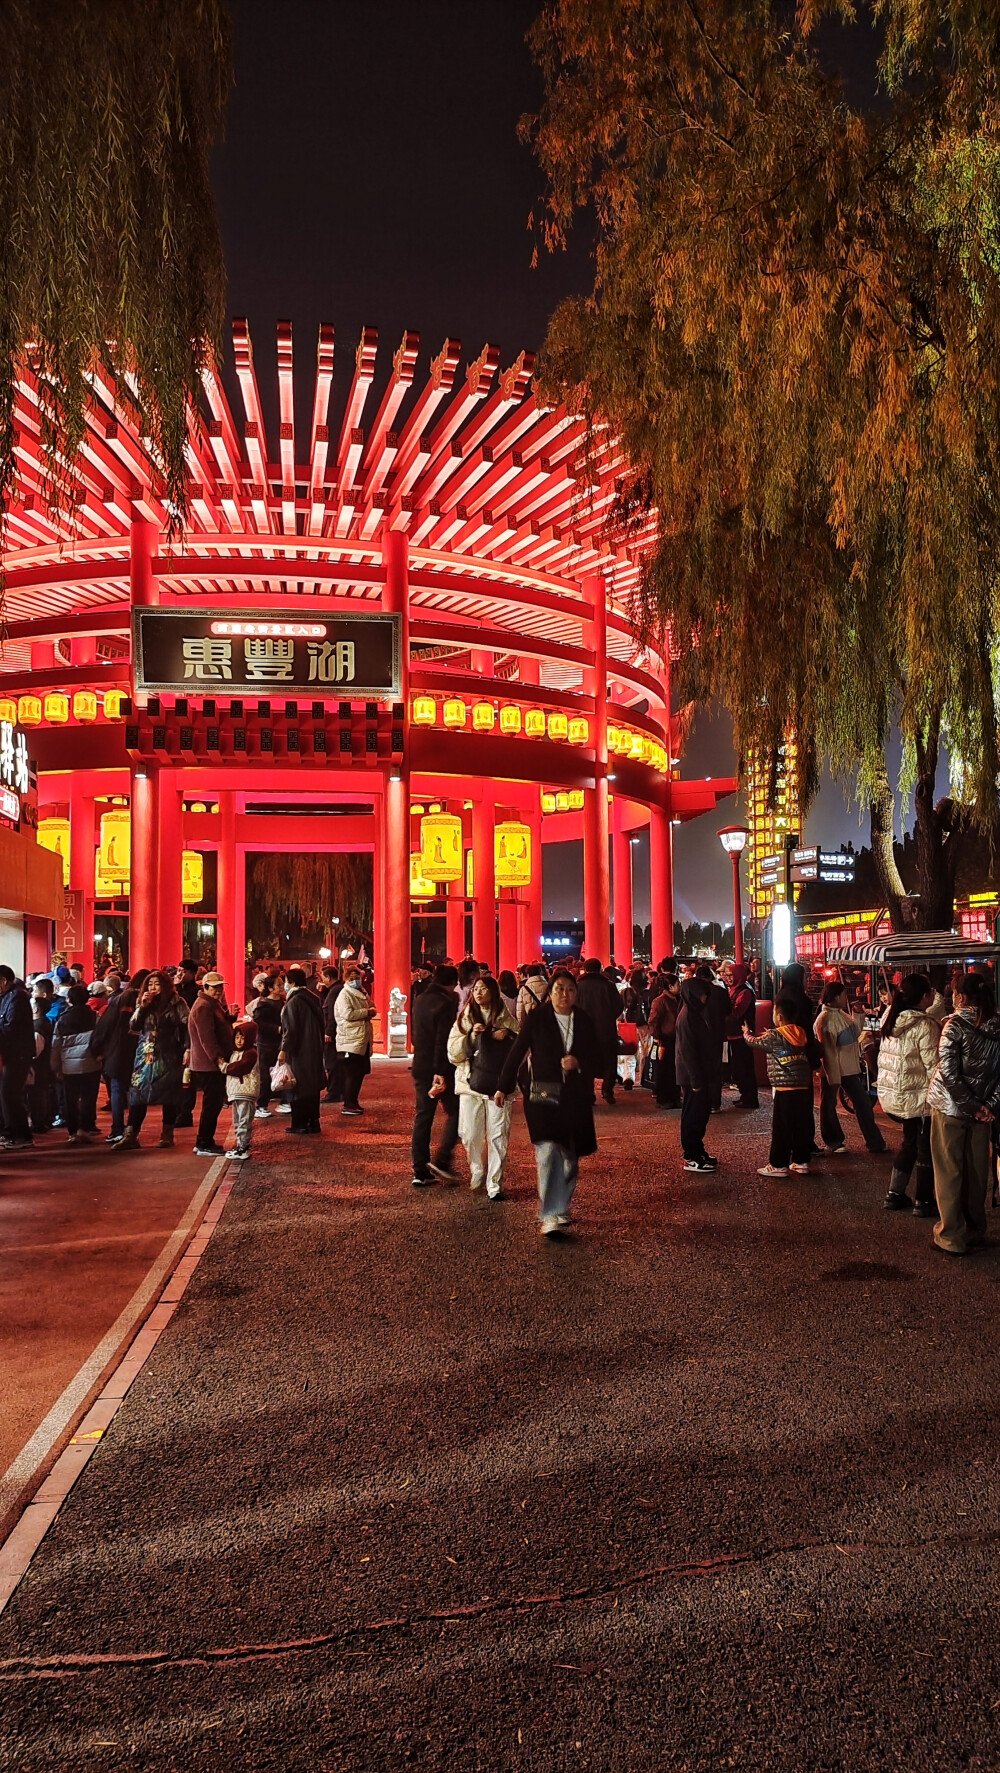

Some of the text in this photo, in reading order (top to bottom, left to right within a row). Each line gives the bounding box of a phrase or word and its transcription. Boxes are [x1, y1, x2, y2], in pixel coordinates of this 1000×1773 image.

[182, 637, 356, 682] 惠豐湖
[63, 893, 76, 949] 团队入口
